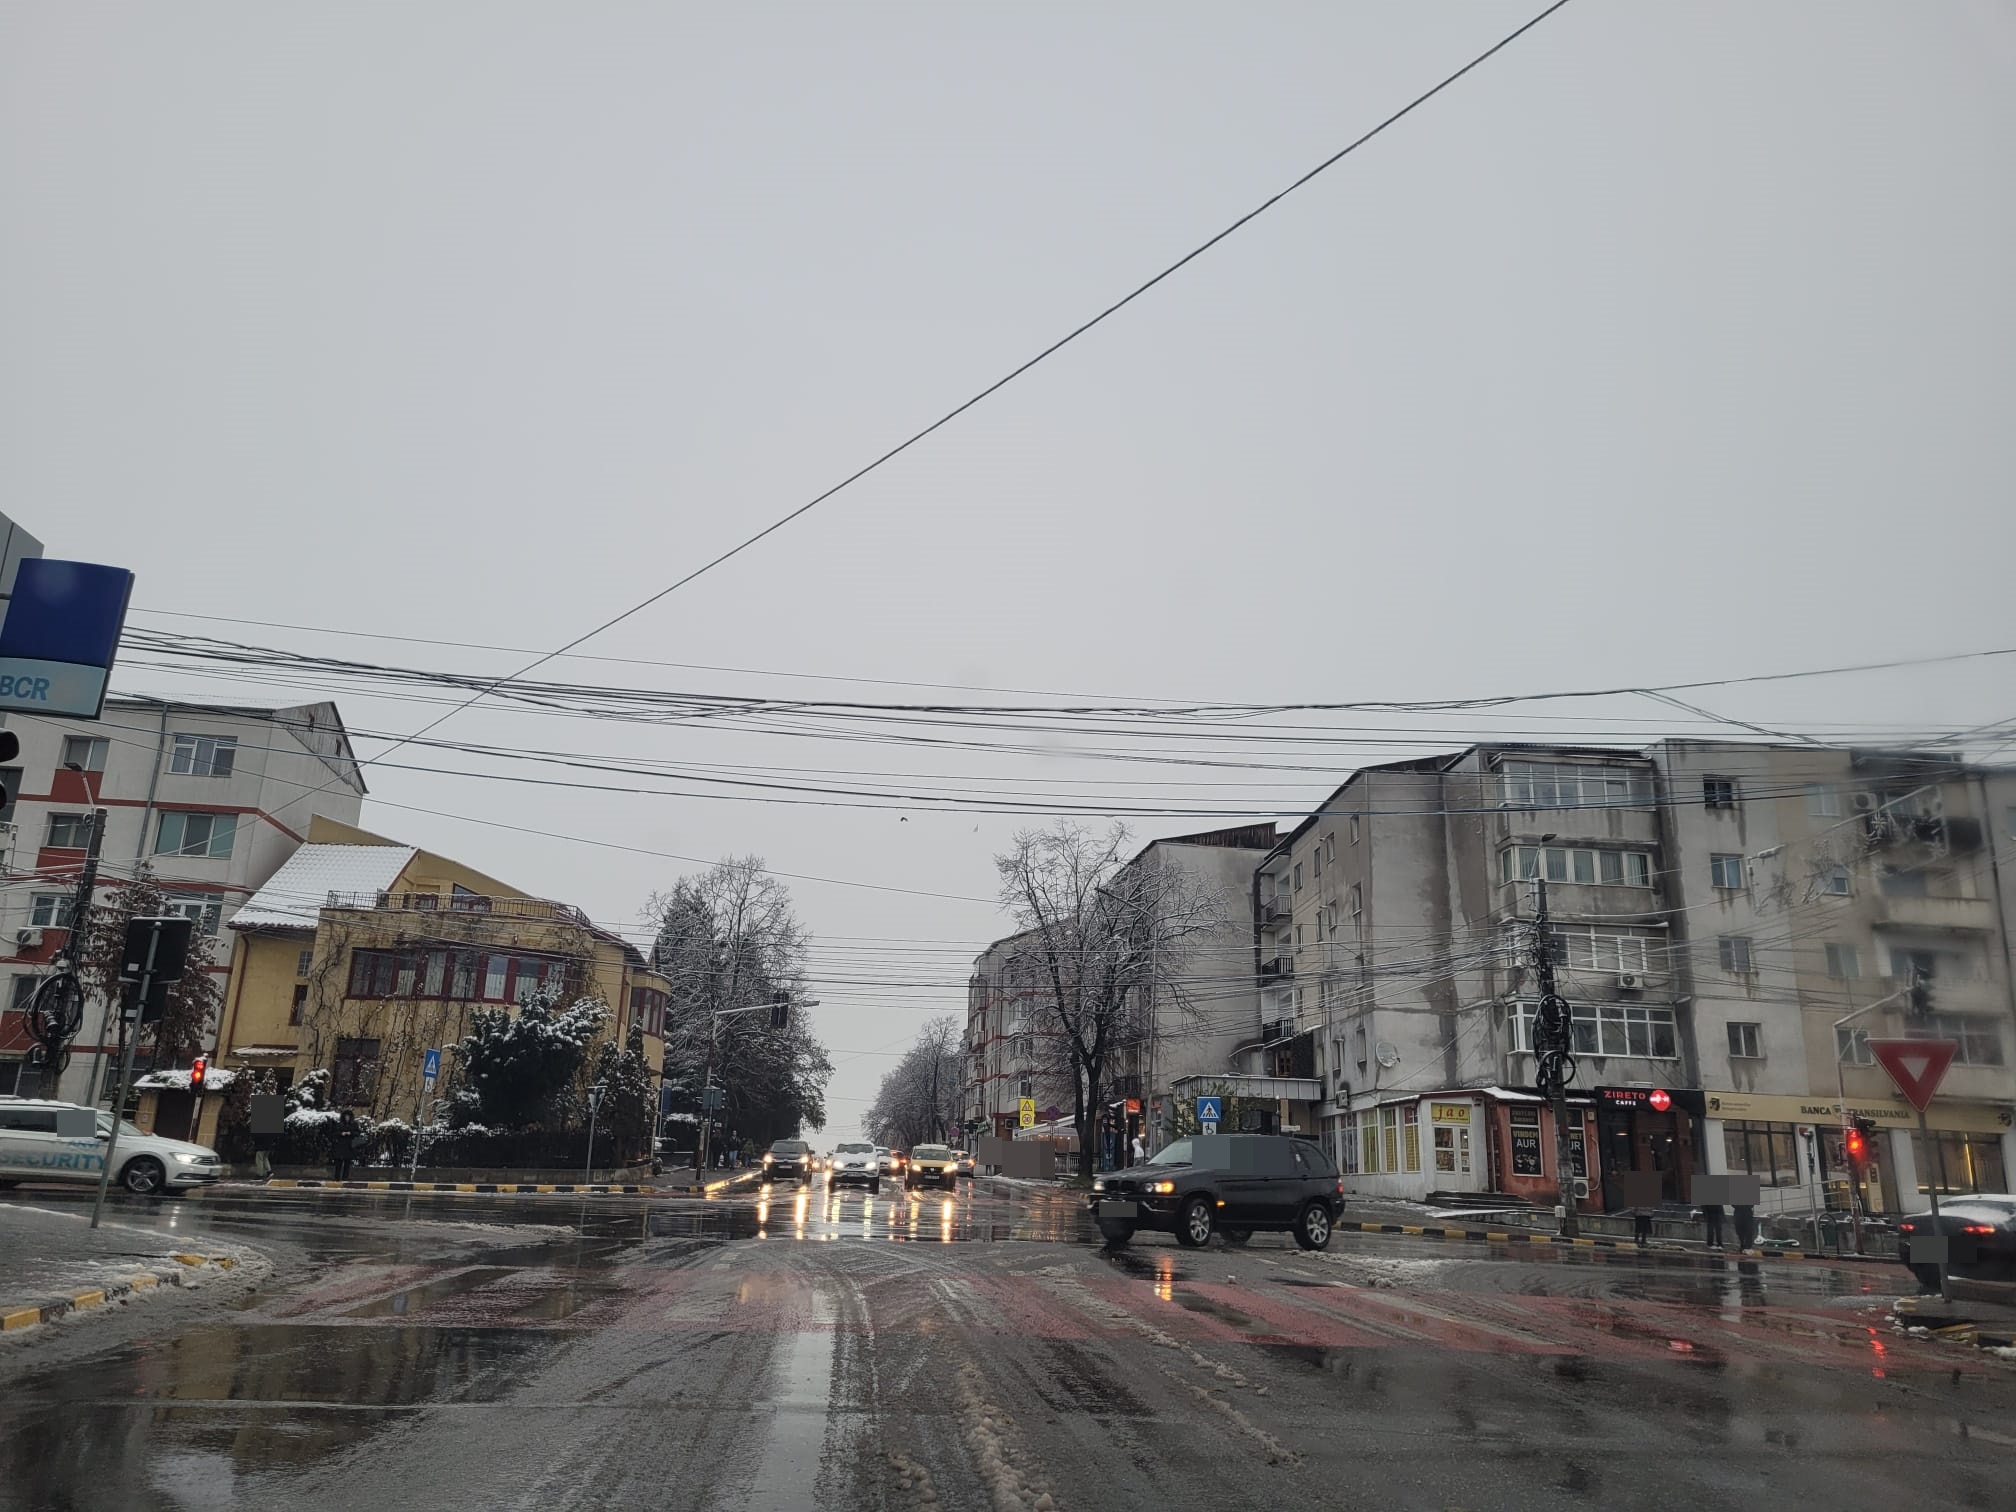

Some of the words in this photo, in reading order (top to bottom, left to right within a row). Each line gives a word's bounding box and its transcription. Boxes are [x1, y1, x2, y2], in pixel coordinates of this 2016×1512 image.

[0, 675, 50, 701] BCR
[1604, 1089, 1646, 1100] ZIRETO
[1800, 1105, 1832, 1115] BANCA
[1847, 1108, 1911, 1119] TRANSILVANIA
[1516, 1138, 1537, 1149] AUR
